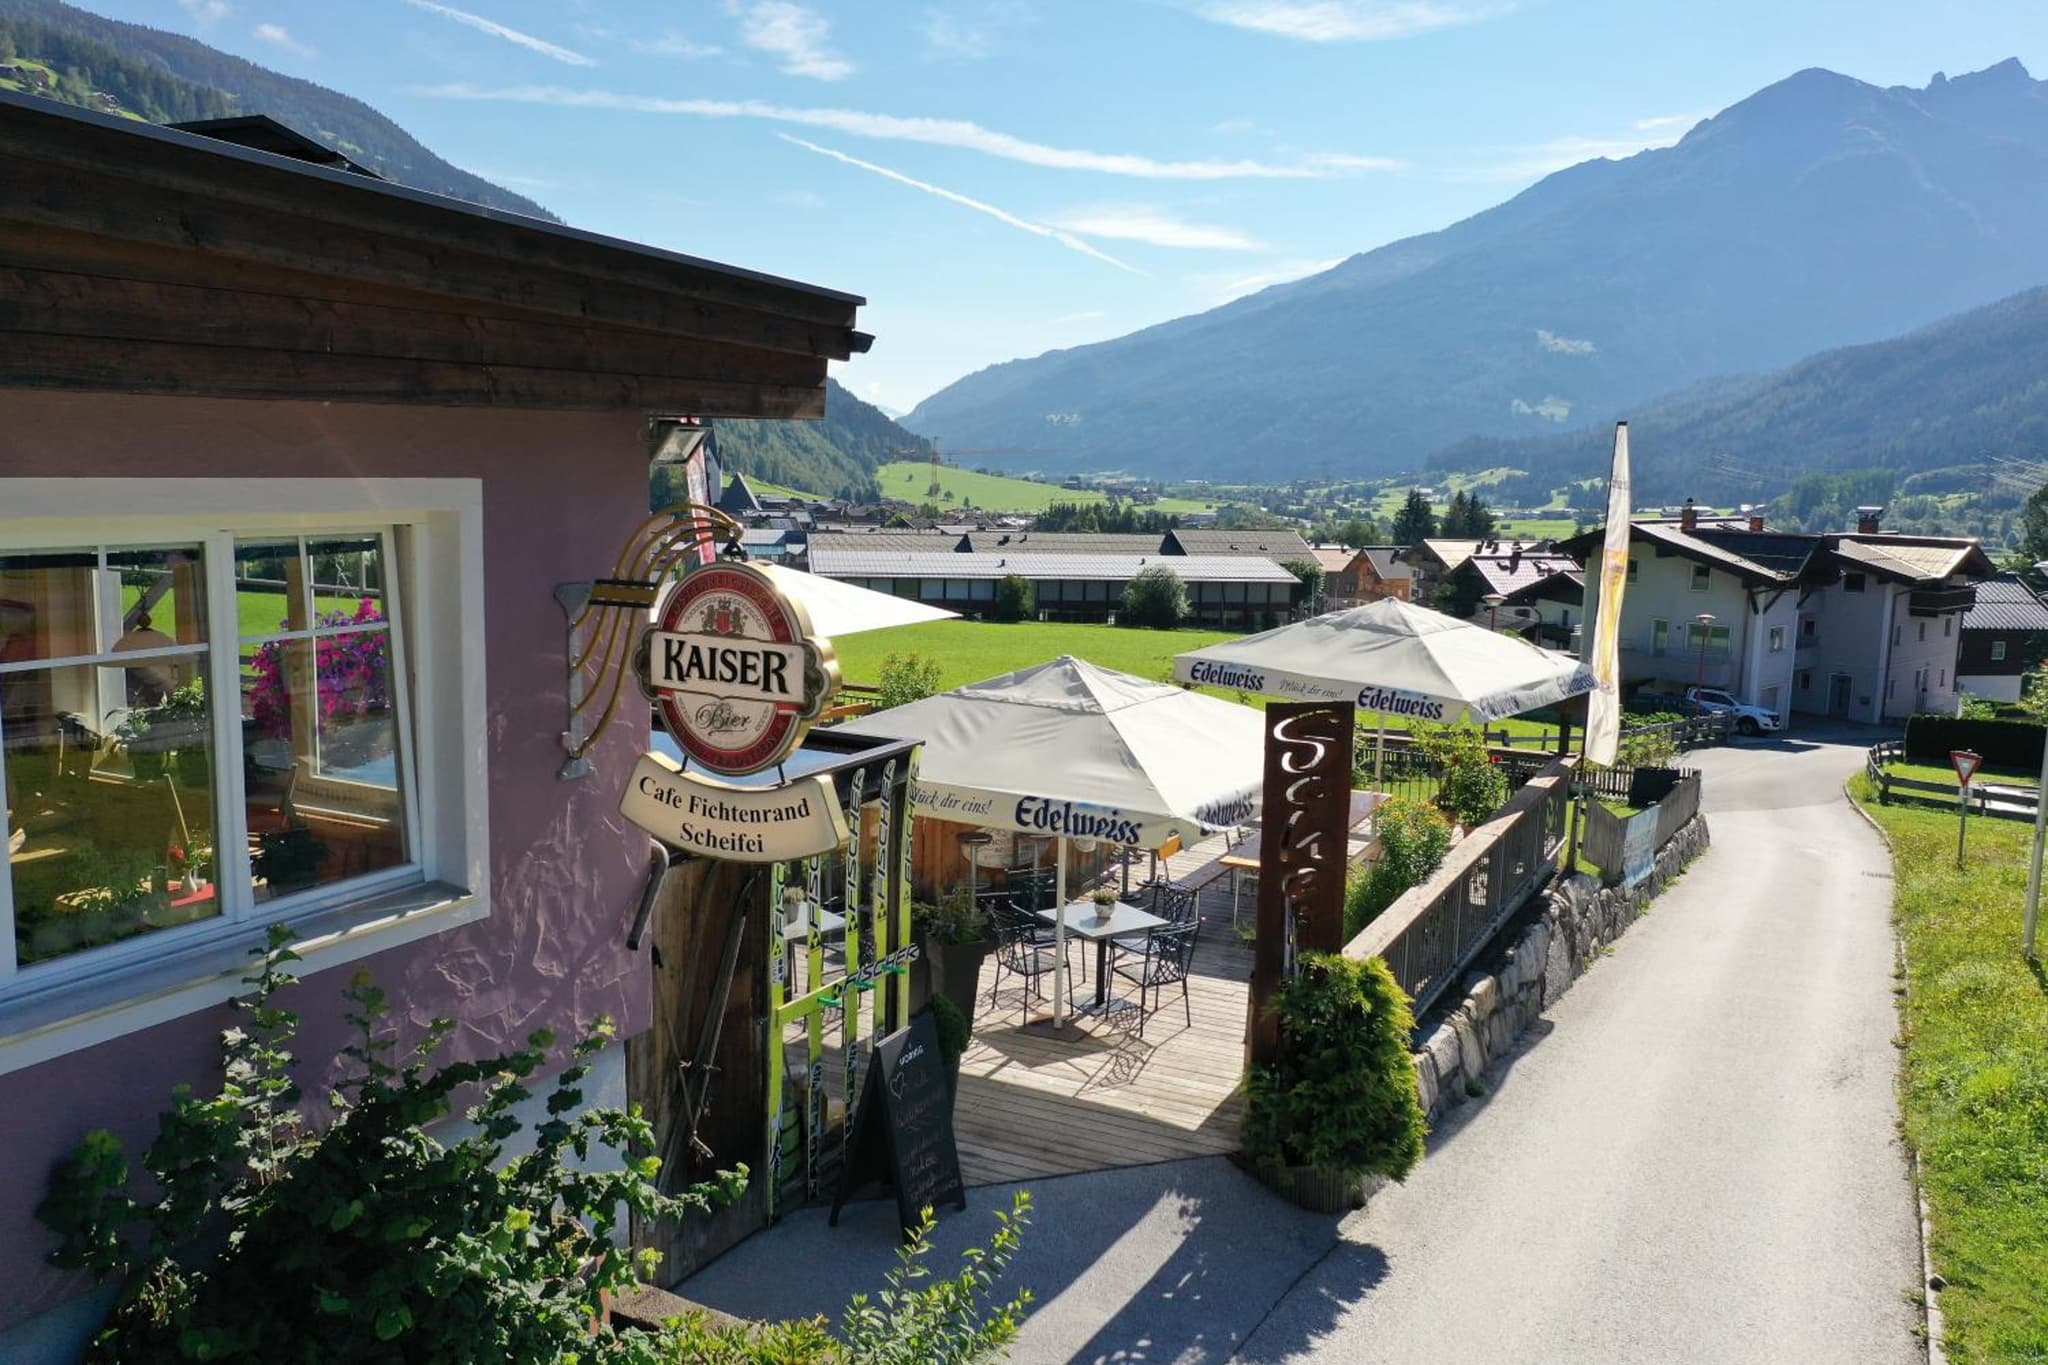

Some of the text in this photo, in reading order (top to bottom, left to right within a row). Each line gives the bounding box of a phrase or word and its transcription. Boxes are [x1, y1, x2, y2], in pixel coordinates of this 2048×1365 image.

[664, 638, 789, 695] KAISER
[1190, 661, 1265, 691] Edelweiss
[695, 701, 752, 731] Bier
[1357, 686, 1444, 720] Edelweiss
[639, 776, 811, 823] Cafe Fichtenrand
[940, 793, 960, 808] dir
[961, 796, 993, 815] eins!
[1014, 796, 1144, 845] Edelweiss
[680, 822, 765, 853] Scheifei
[846, 771, 865, 913] FISCHER
[877, 760, 895, 900] FISCHER
[774, 864, 785, 937] FISC
[808, 855, 820, 930] FISC
